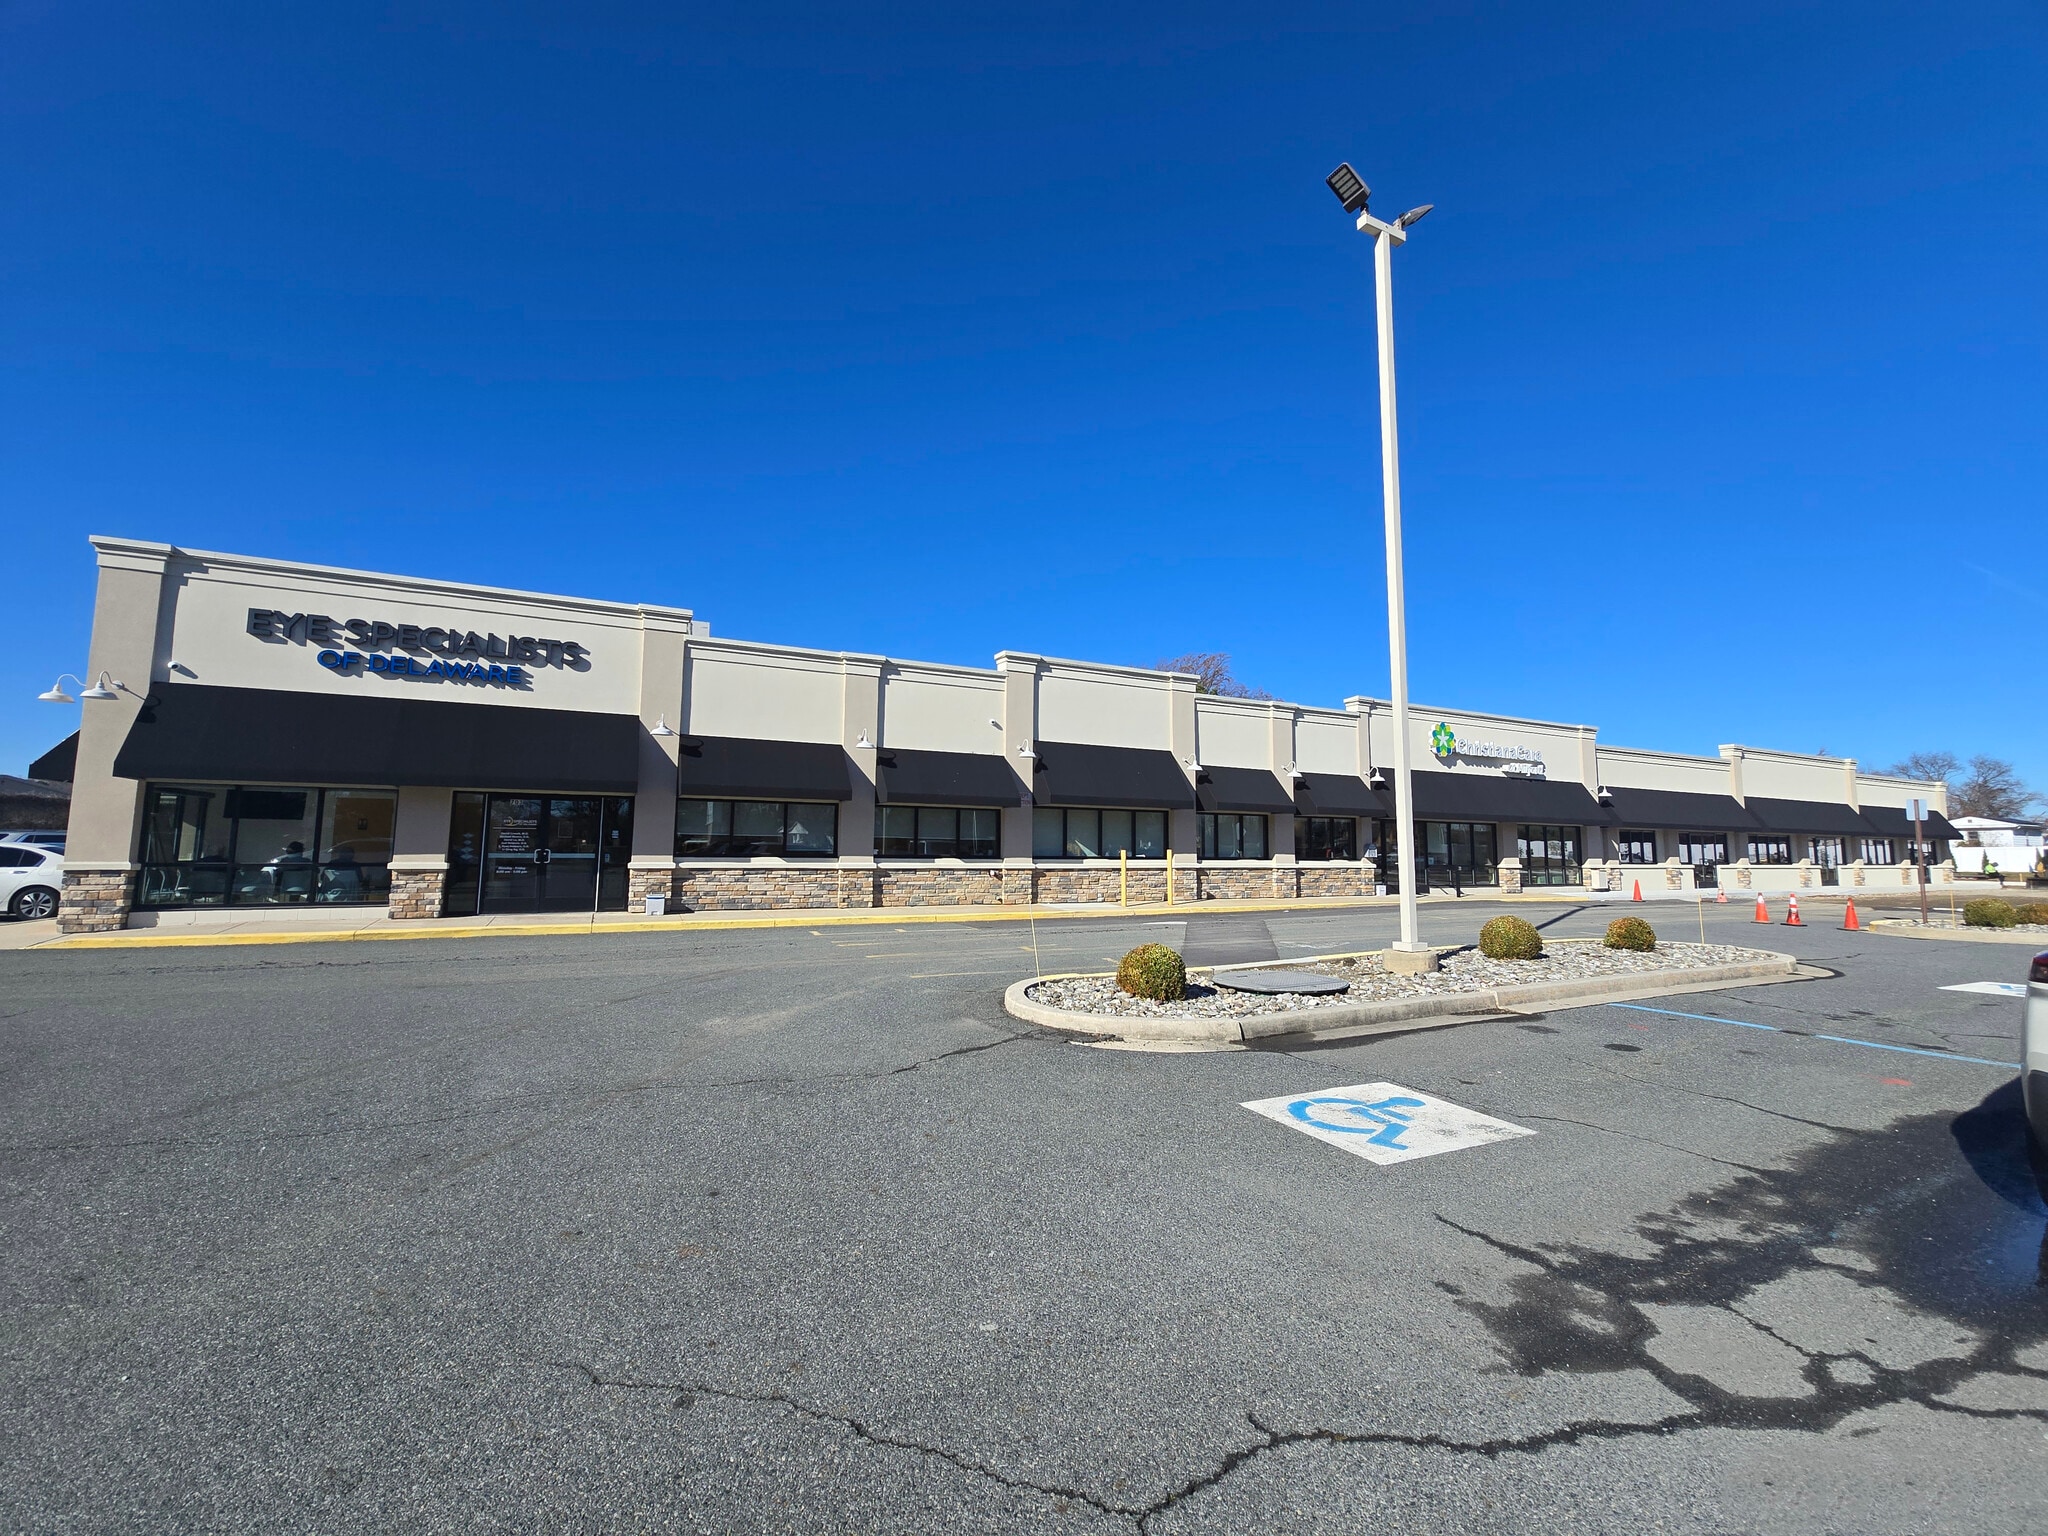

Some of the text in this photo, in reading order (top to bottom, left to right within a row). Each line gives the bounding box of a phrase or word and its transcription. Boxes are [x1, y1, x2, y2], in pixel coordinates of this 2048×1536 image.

[247, 607, 582, 666] EYE SPECIALISTS
[317, 649, 522, 684] OF DELAWARE
[1458, 738, 1542, 761] ChristianaCare
